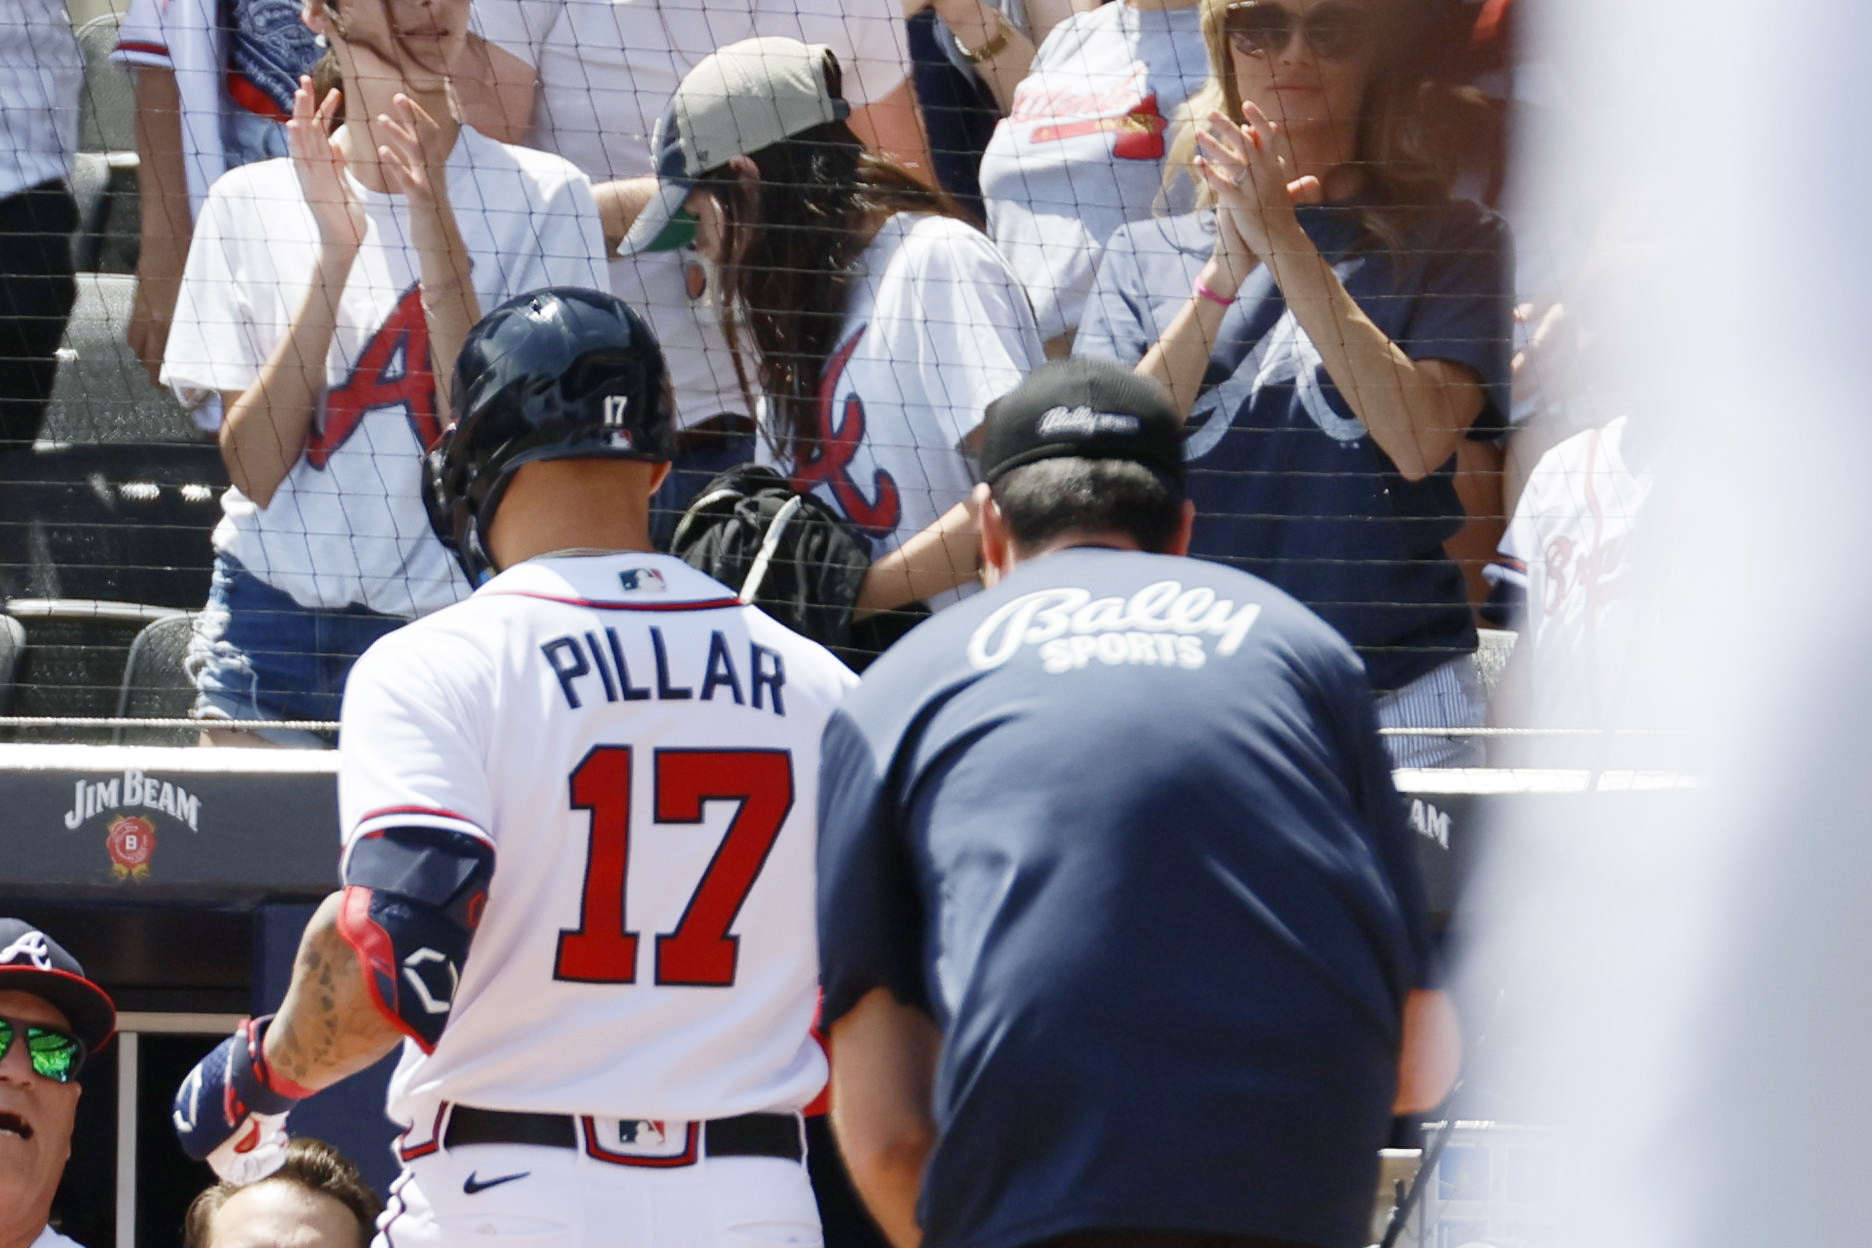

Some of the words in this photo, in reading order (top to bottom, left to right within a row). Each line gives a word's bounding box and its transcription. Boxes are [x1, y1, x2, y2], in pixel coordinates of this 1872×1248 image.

[604, 394, 628, 427] 17
[968, 580, 1263, 671] Bally
[1039, 630, 1207, 674] SPORTS
[540, 625, 787, 717] PILLAR
[64, 779, 120, 830] JIM
[123, 768, 202, 832] BEAM
[125, 834, 138, 850] B
[552, 743, 796, 987] 17
